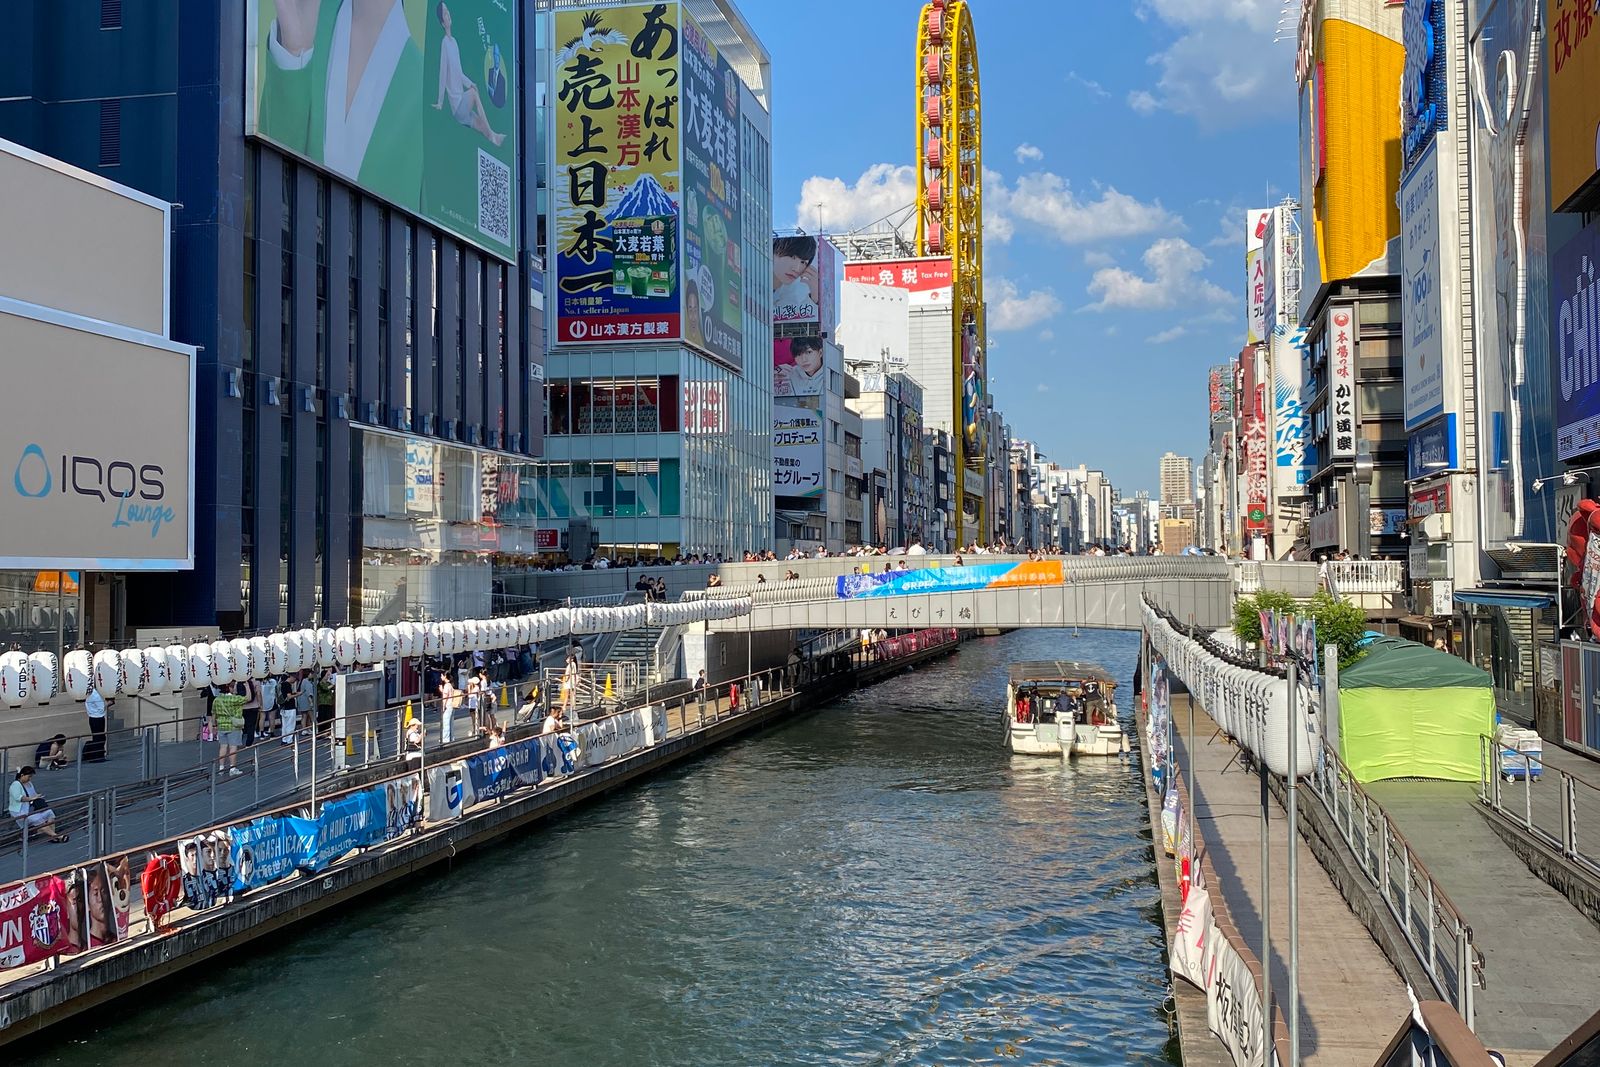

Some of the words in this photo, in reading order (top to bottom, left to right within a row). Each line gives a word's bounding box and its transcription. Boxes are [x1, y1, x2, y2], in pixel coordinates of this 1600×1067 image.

[630, 4, 678, 162] あっぱれ
[616, 59, 641, 166] 山本漢方
[686, 77, 737, 180] 大麦若葉
[558, 54, 615, 293] 売上日本一
[616, 236, 664, 252] 大麦若葉
[591, 321, 669, 336] 山本漢方製薬
[774, 432, 818, 444] プロデュース
[1335, 383, 1352, 451] かに道楽
[61, 455, 165, 503] IQOS
[1248, 418, 1267, 499] 大阪王将
[112, 488, 175, 538] Lounge
[889, 607, 971, 620] えびす橋
[18, 659, 27, 697] PABLO
